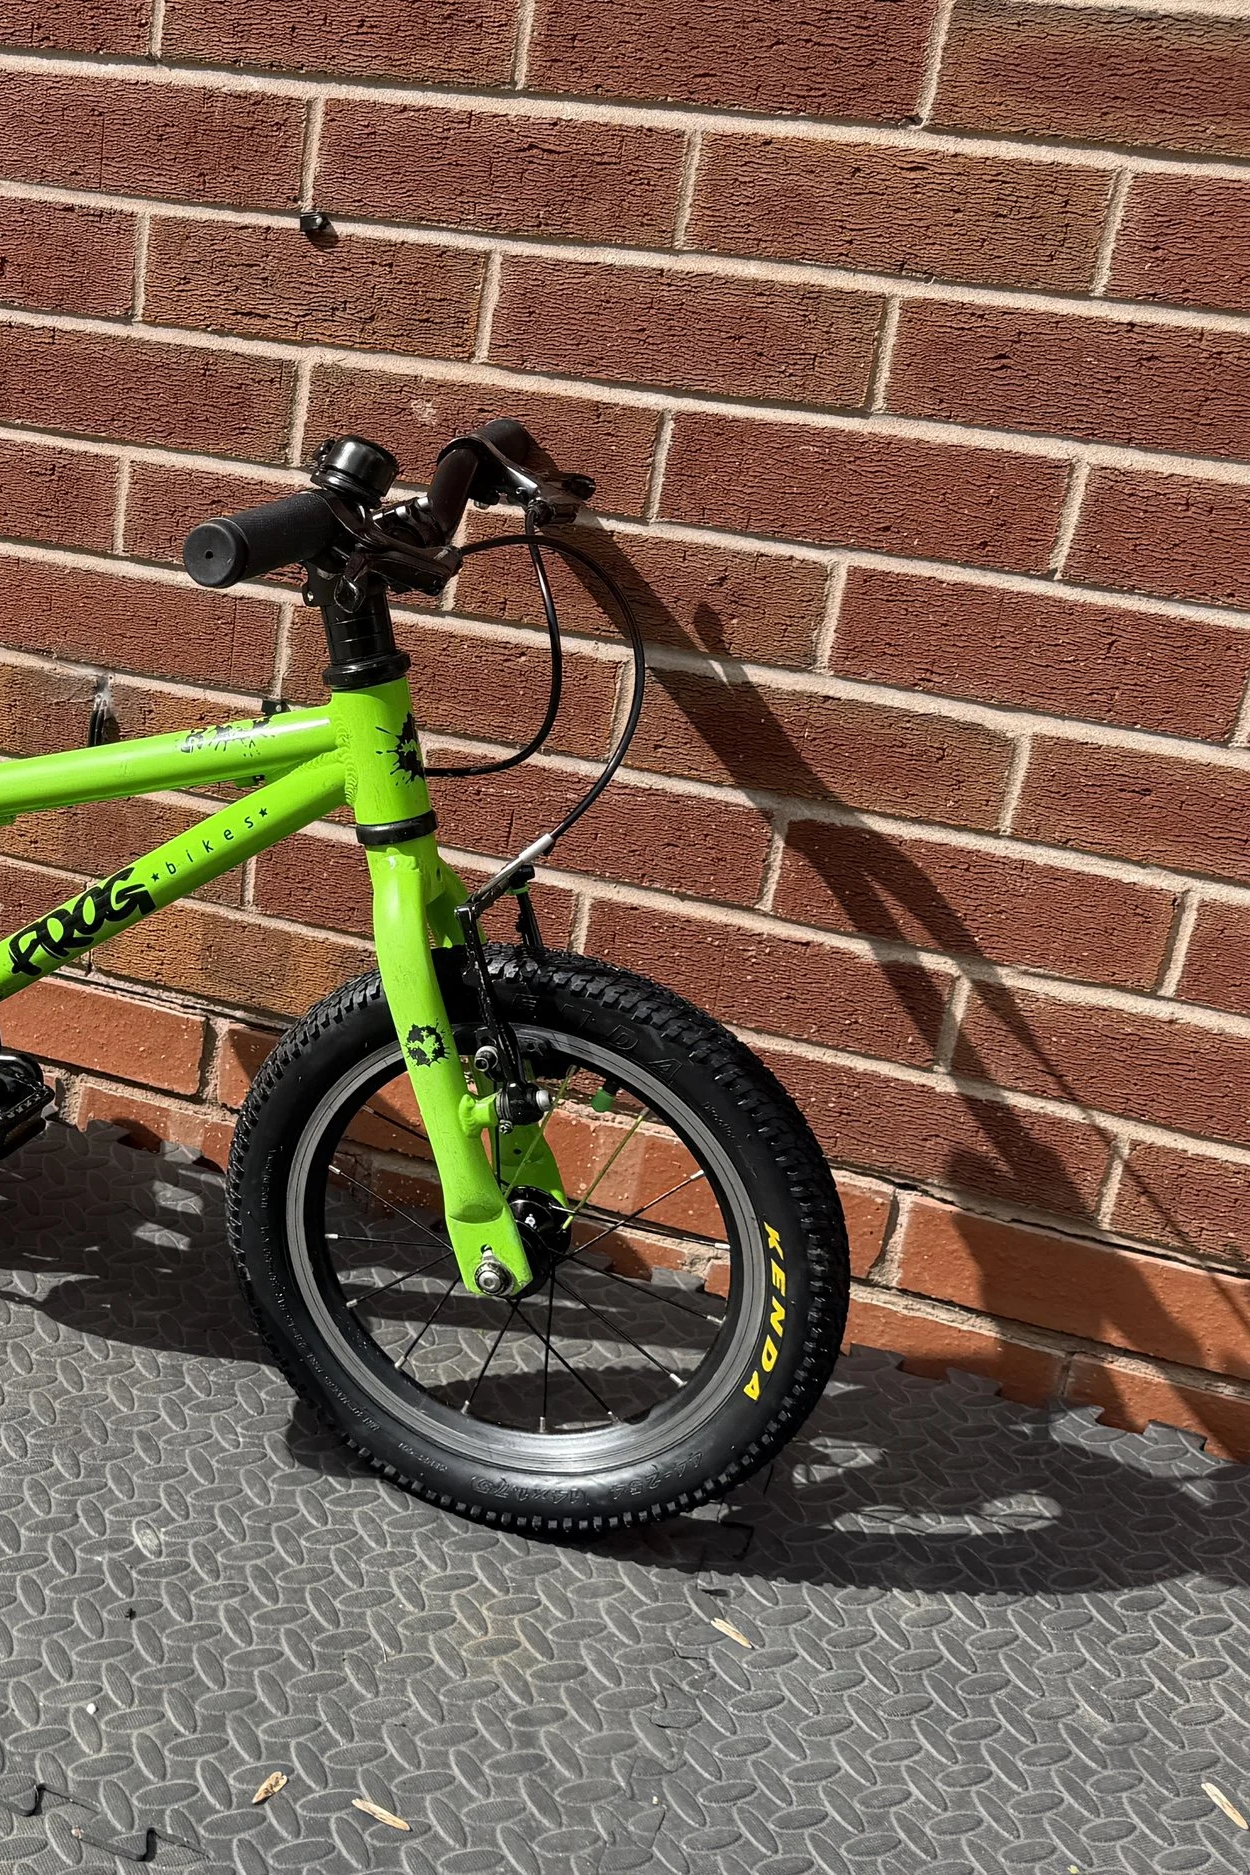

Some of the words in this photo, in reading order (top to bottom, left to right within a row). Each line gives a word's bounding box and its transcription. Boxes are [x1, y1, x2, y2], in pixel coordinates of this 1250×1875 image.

[7, 866, 157, 977] FROG
[165, 814, 255, 876] bikes
[743, 1221, 787, 1401] KENDA
